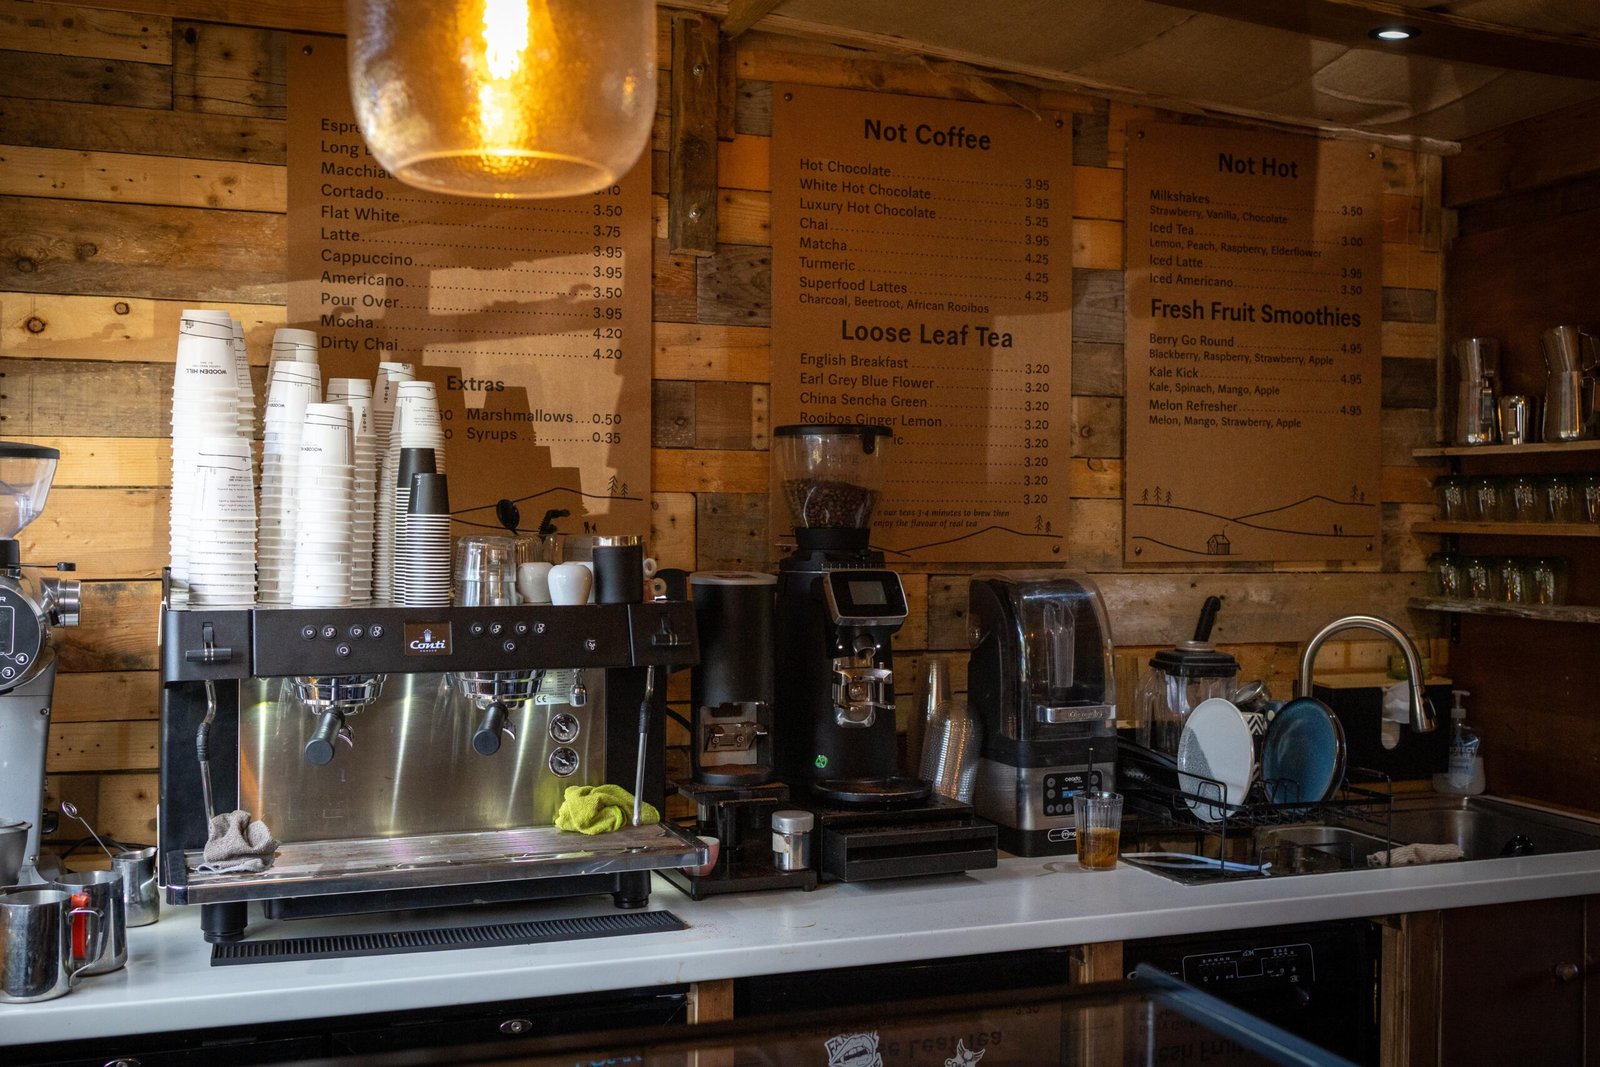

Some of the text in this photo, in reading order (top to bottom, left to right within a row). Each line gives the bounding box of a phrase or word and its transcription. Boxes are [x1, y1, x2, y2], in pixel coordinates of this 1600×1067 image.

[864, 119, 992, 150] Not Coffee
[321, 140, 359, 159] Long
[800, 158, 1049, 190] Hot Chocolate 3.95
[1218, 153, 1298, 179] Not Hot
[321, 183, 623, 217] Cortado 3.50
[800, 179, 1049, 209] White Hot Chocolate 3.95
[1150, 189, 1363, 217] Milkshakes 3.50
[321, 205, 621, 238] Flat White 3.75
[800, 198, 1048, 228] Luxury Hot Chocolate 5.25
[1206, 209, 1240, 222] Vanilla,
[1242, 212, 1288, 224] Chocolate
[321, 227, 623, 259] Latte 3.95
[800, 217, 1049, 246] Chai 3.95
[1150, 222, 1363, 248] Iced Tea 3.00
[800, 237, 1049, 265] Matcha 4.25
[1150, 239, 1184, 250] Lemon,
[1187, 240, 1218, 253] Peach,
[1271, 246, 1322, 258] Elderflower
[321, 249, 622, 279] Cappuccino 3.95
[799, 257, 1049, 284] Turmeric 4.25
[1150, 255, 1362, 280] Iced Latte 3.95
[321, 271, 623, 299] Americano 3.50
[799, 276, 1049, 302] Superfood Lattes 4.25
[1150, 272, 1362, 296] Iced Americano 3.50
[321, 292, 623, 320] Pour Over 3.95
[799, 294, 989, 314] Charcoal, Beetroot, African Rooibos
[1151, 299, 1361, 328] Fresh Fruit Smoothies
[321, 314, 623, 340] Mocha 4.20
[841, 320, 1013, 348] Loose Leaf Tea
[321, 336, 623, 360] Dirty Chai 4.20
[1150, 333, 1362, 354] Berry Go Round 4.95
[800, 353, 1050, 375] English Breakfast 3.20
[1150, 349, 1334, 366] Blackberry, Raspberry, Strawberry, Apple
[446, 375, 505, 393] Extras
[800, 373, 1049, 393] Earl Grey Blue Flower 3.20
[1150, 366, 1362, 385] Kale Kick 4.95
[1149, 382, 1280, 397] Kale, Spinach, Mango, Apple
[800, 392, 1049, 412] China Sencha Green 3.20
[1149, 399, 1362, 416] Melon Refresher 4.95
[466, 408, 574, 423] Marshmallows
[592, 413, 622, 425] 0.50
[800, 412, 1049, 430] Rooibos Ginger Lemon 3.20
[1149, 415, 1302, 429] Melon, Mango, Strawberry, Apple
[466, 427, 518, 443] Syrups
[592, 432, 621, 444] 0.35
[1024, 438, 1048, 449] 3.20
[1024, 457, 1048, 468] 3.20
[1024, 475, 1048, 486] 3.20
[1024, 494, 1048, 505] 3.20
[410, 640, 446, 649] Conti
